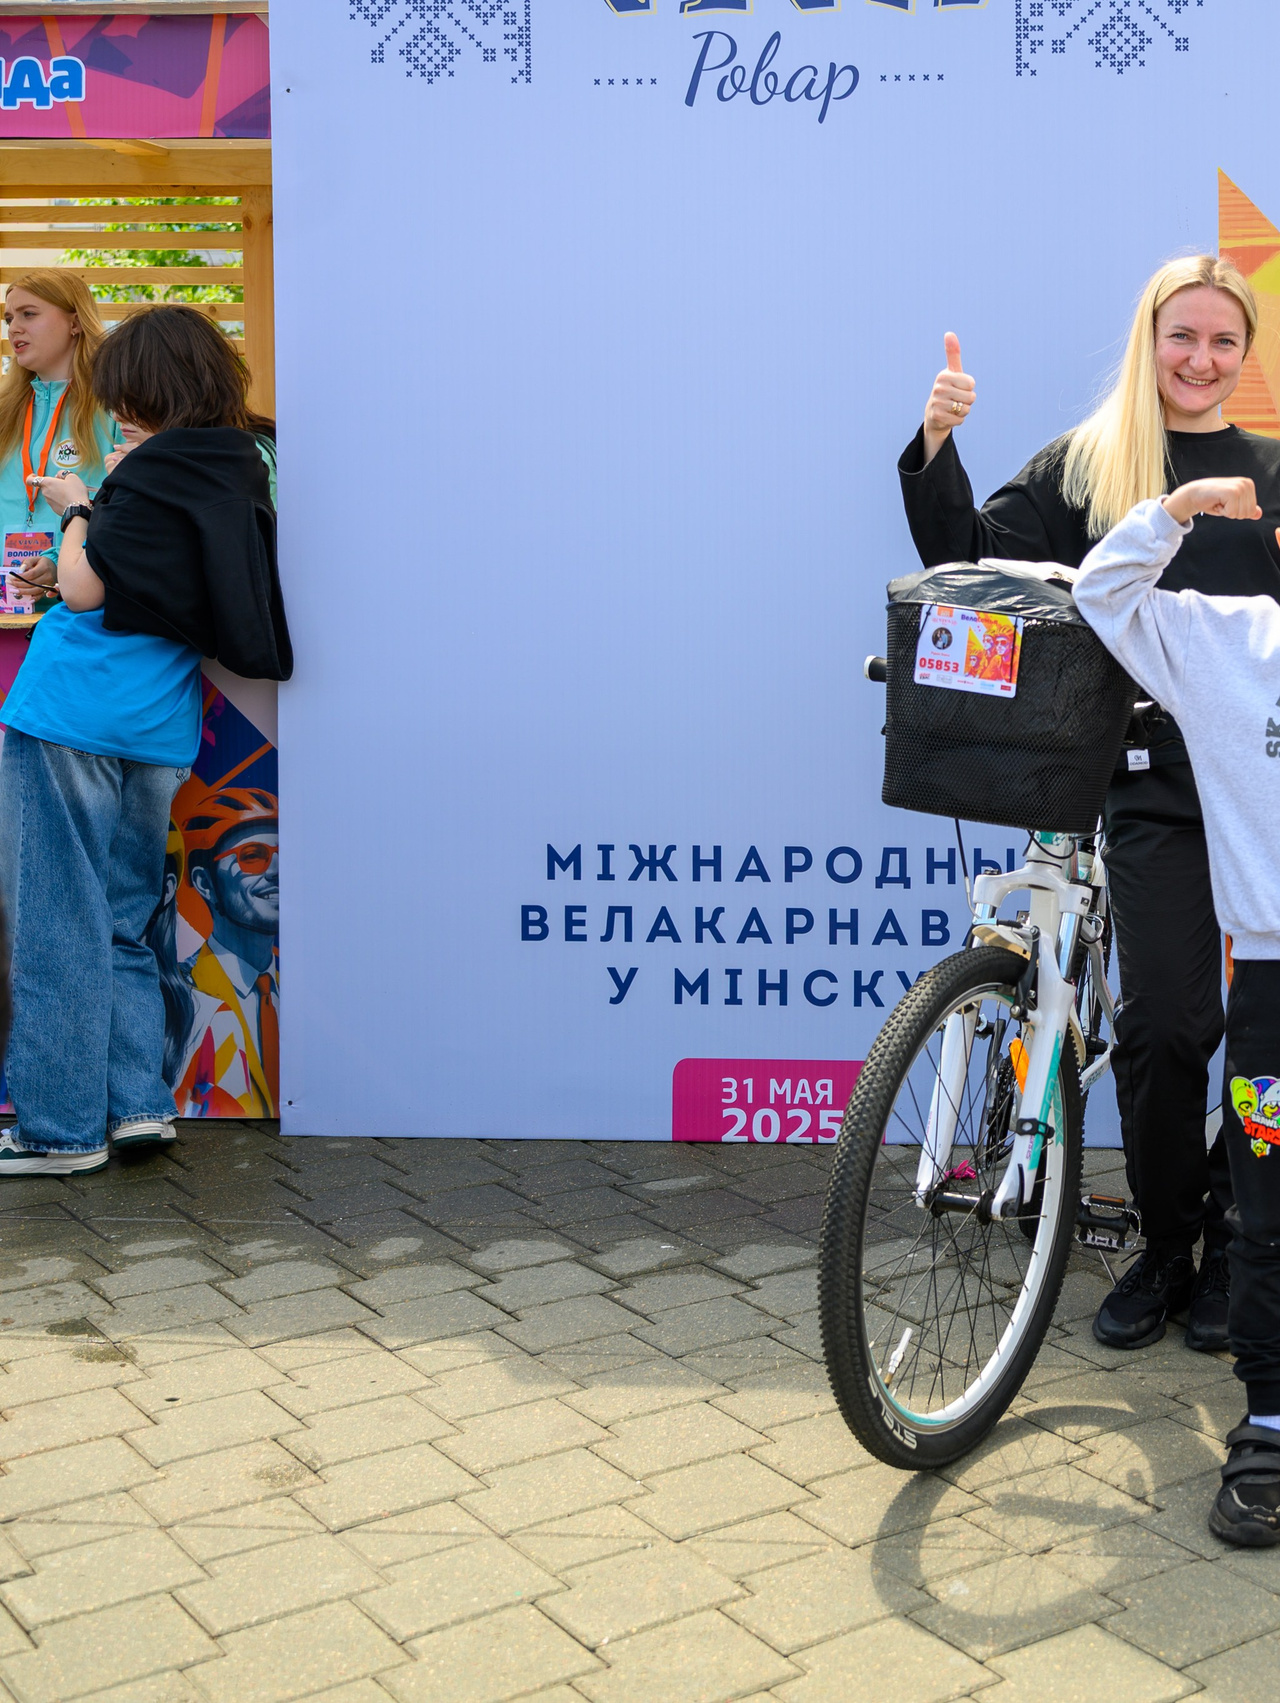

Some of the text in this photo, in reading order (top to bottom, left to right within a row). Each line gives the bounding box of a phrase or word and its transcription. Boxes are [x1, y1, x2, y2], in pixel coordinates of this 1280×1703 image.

[0, 56, 86, 110] да
[684, 30, 860, 124] Ровар
[7, 549, 43, 558] ВОЛОНТ
[919, 657, 960, 673] 05853
[521, 904, 975, 946] ВЕЛАКАРНАВ
[606, 966, 639, 1005] У
[721, 1077, 833, 1105] 31 МАЯ
[721, 1107, 844, 1143] 2025
